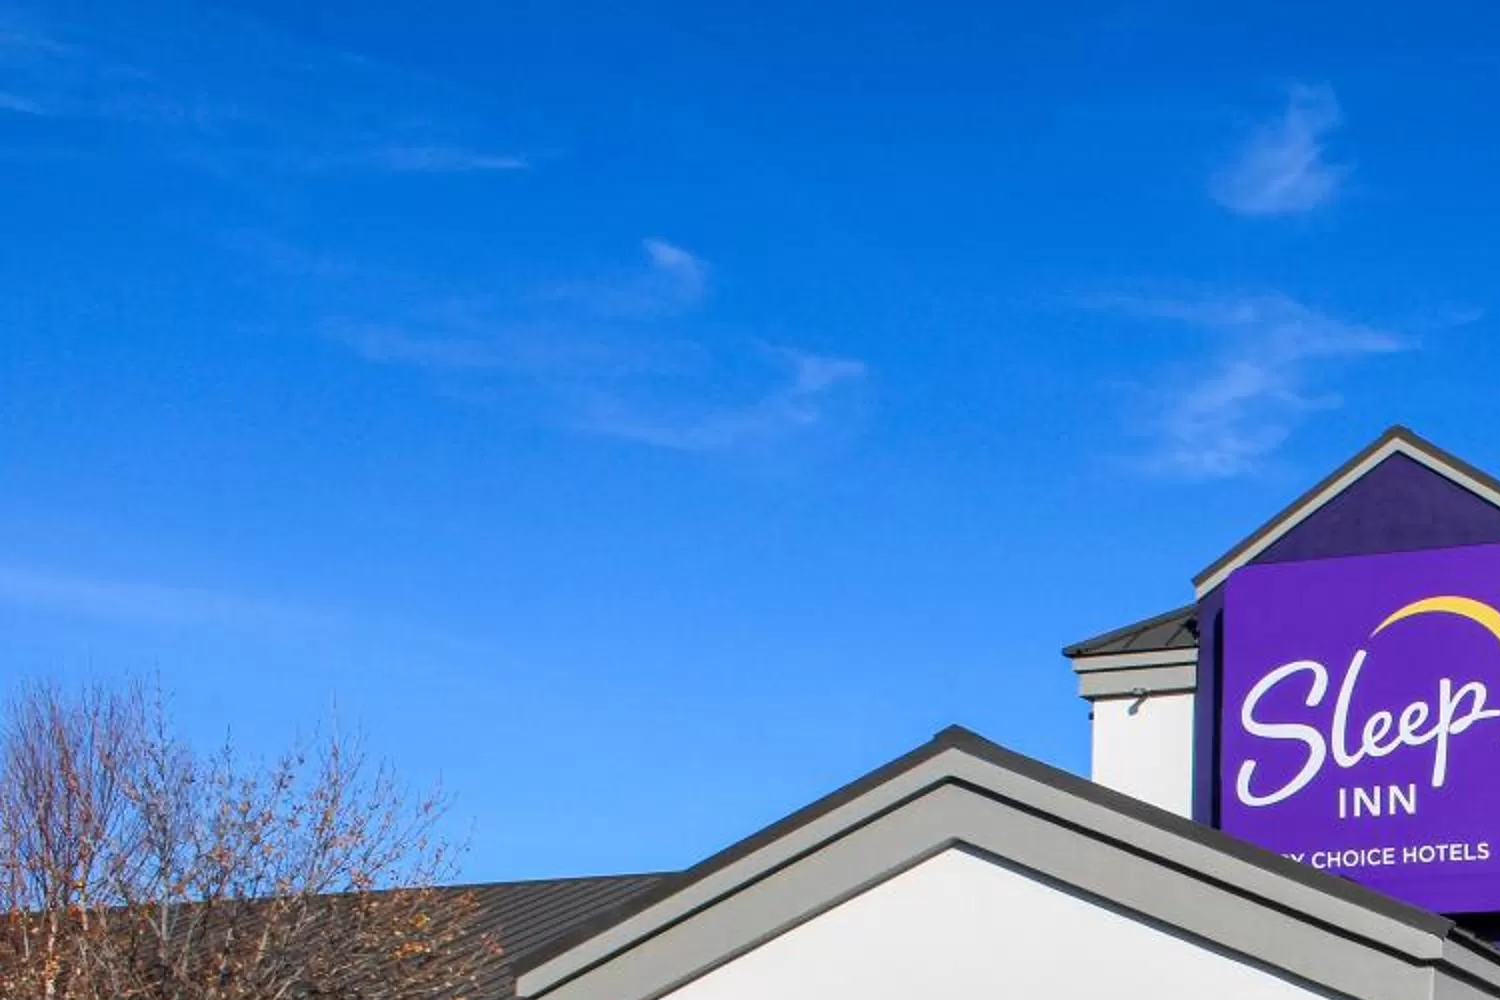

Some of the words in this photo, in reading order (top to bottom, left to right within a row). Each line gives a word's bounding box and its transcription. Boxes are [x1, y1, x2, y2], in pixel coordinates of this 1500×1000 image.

[1338, 783, 1417, 819] INN
[1311, 847, 1395, 869] CHOICE
[1402, 842, 1491, 864] HOTELS
